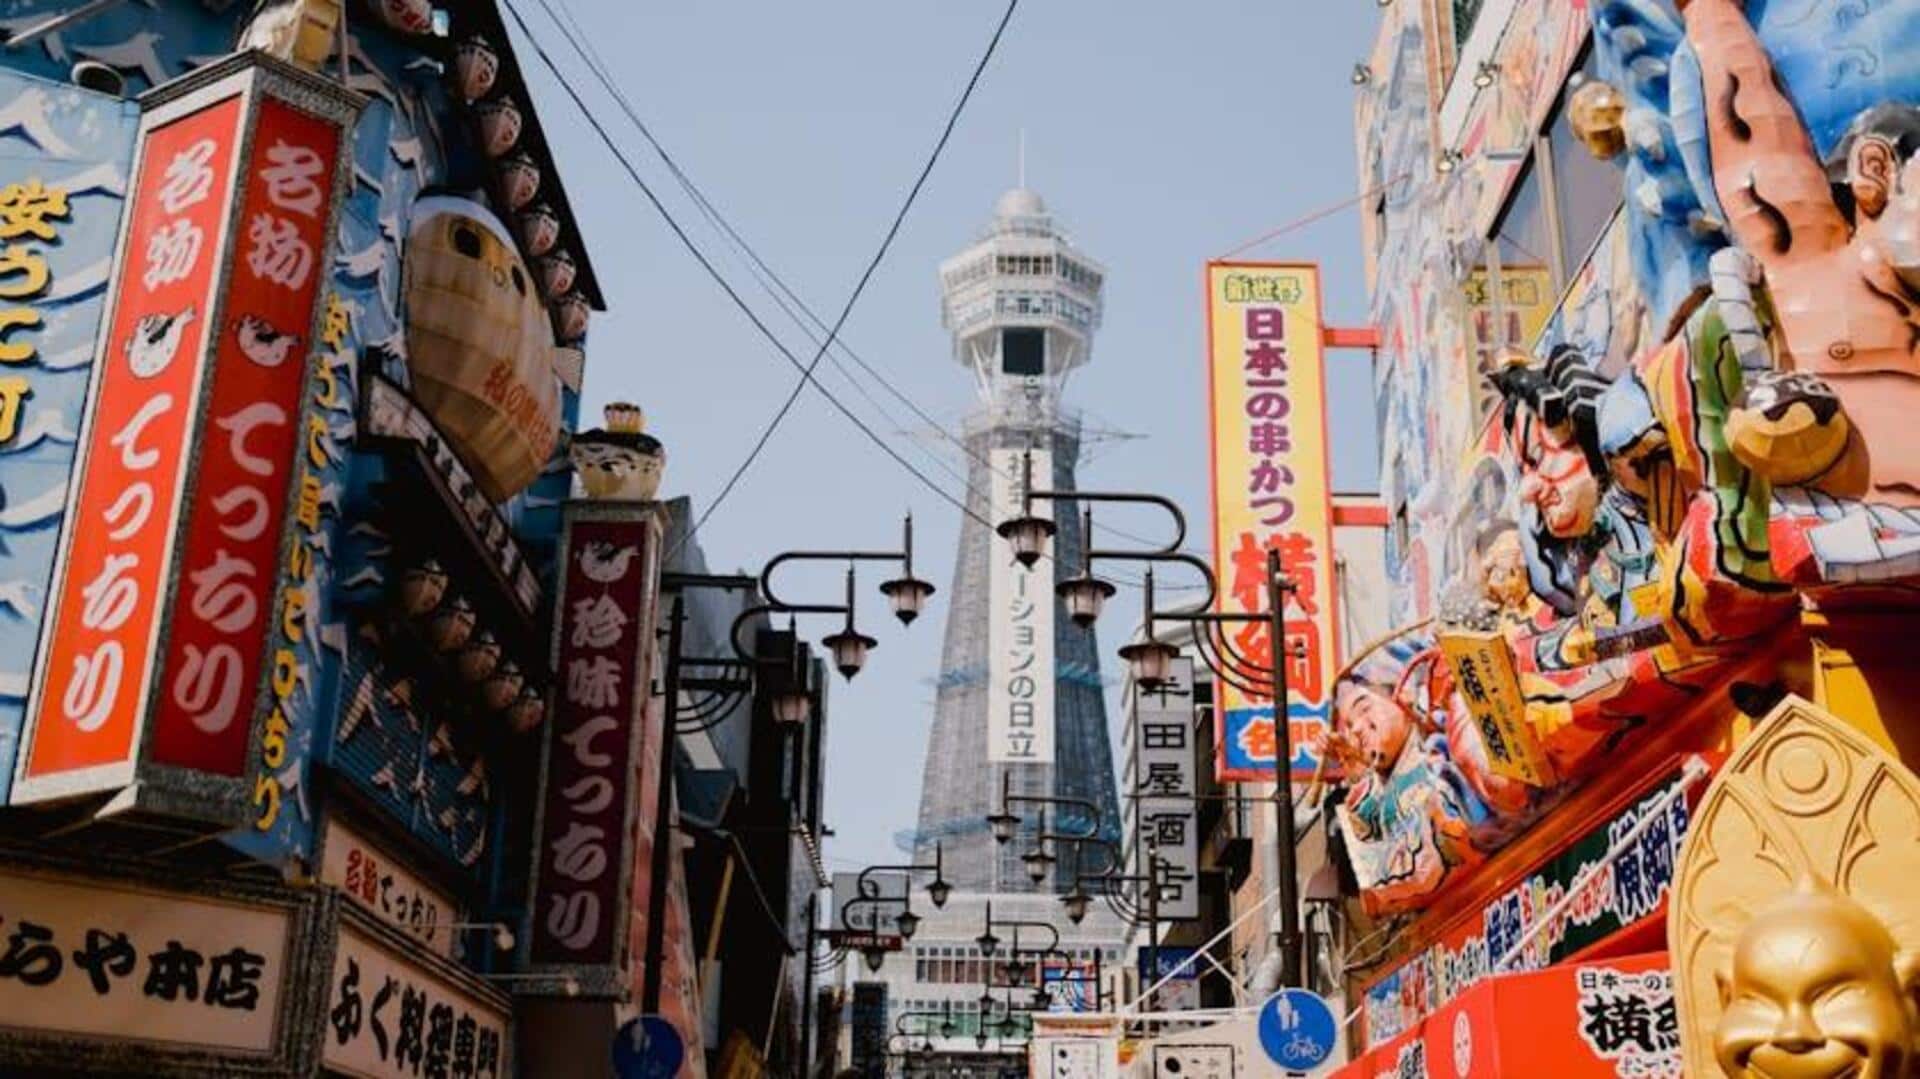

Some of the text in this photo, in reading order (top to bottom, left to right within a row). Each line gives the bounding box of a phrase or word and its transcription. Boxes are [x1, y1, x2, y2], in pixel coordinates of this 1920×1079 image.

[1244, 308, 1295, 525] 日本一の串かつ
[1231, 532, 1323, 705] 横綱
